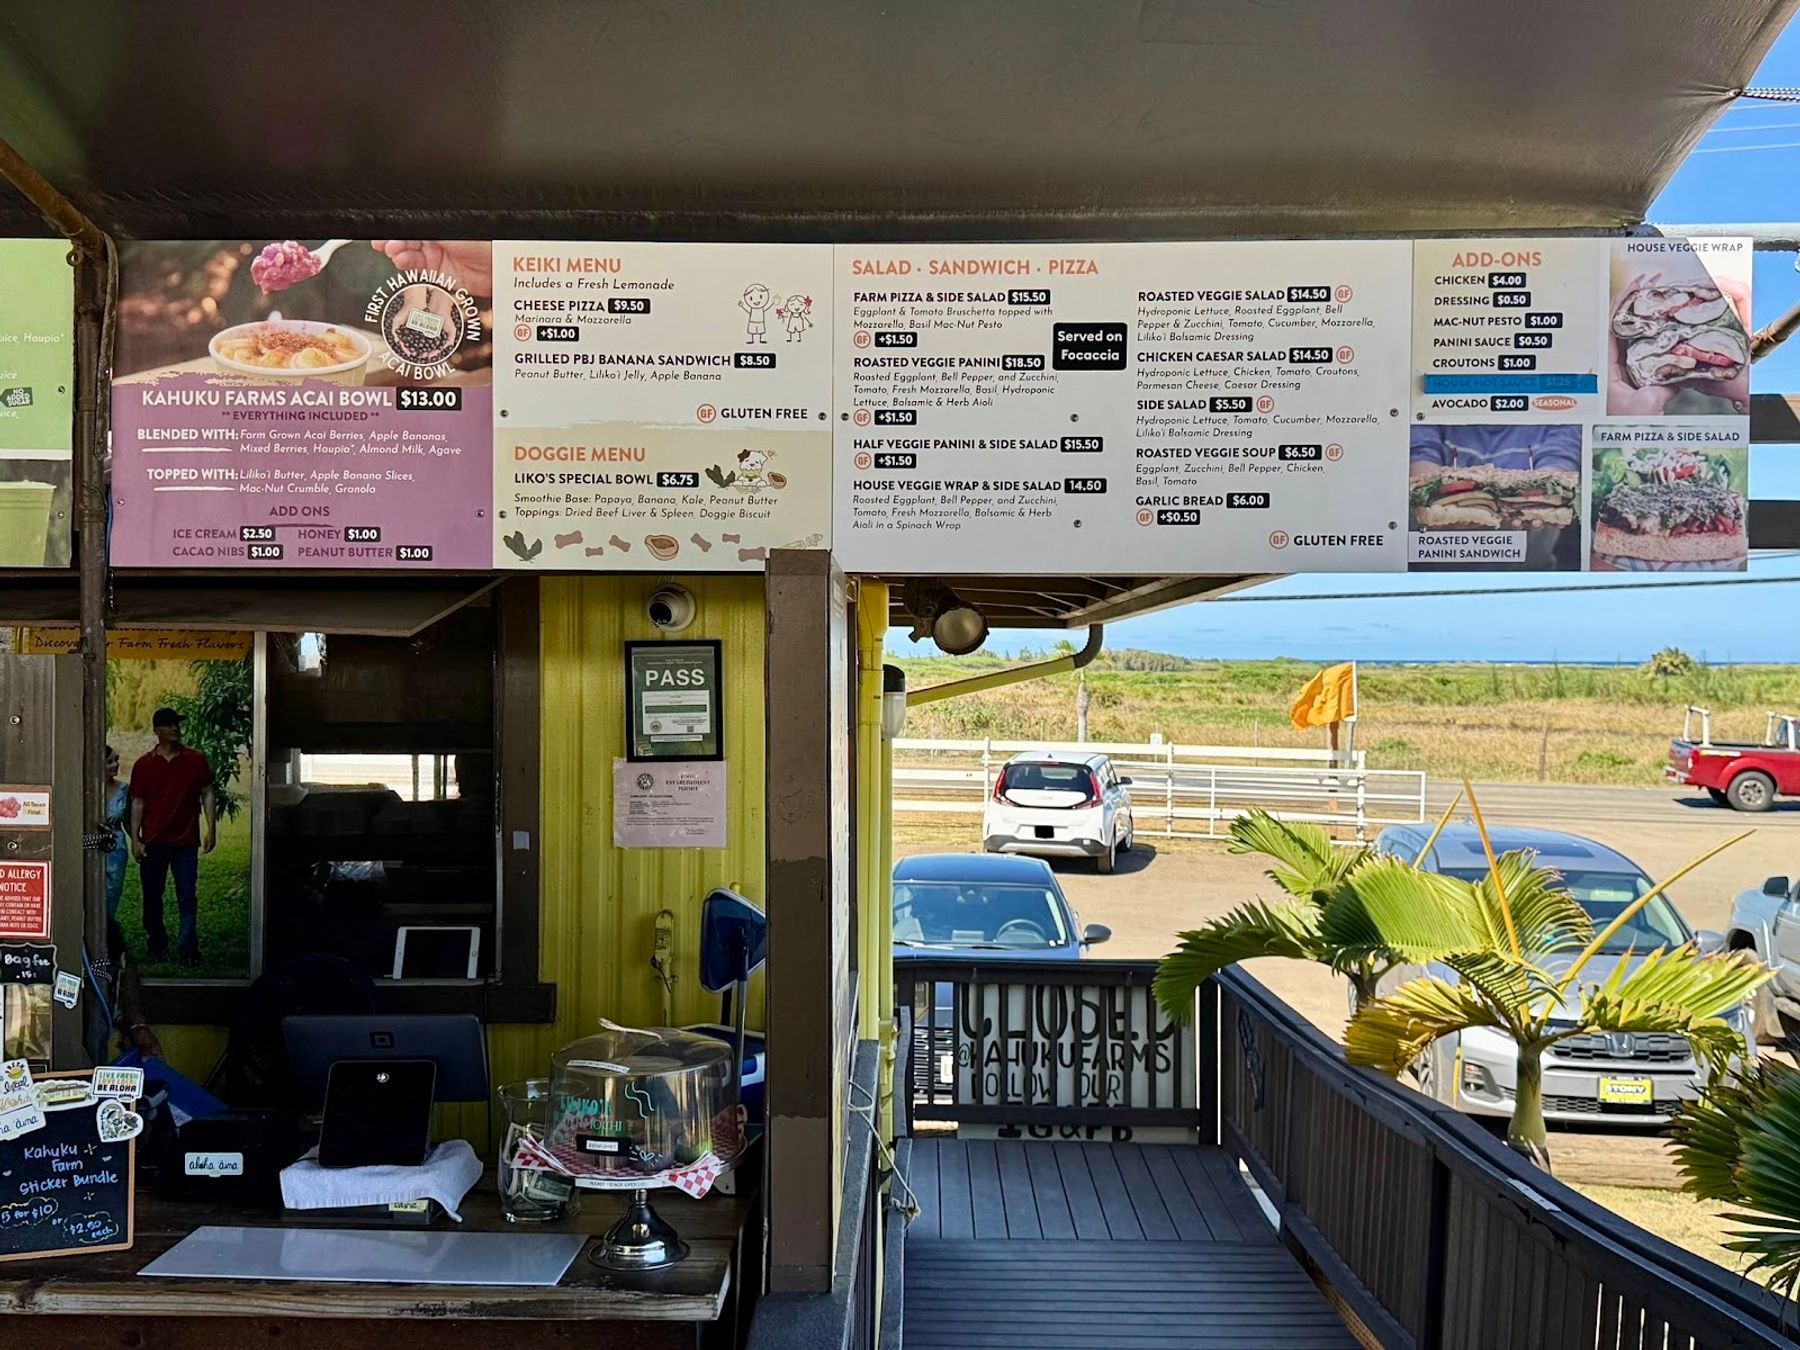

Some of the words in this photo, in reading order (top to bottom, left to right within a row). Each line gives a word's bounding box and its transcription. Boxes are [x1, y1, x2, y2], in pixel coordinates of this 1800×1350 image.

[512, 256, 560, 272] KEIKI
[566, 258, 621, 273] MENU
[1452, 251, 1542, 268] ADD-ONS
[852, 259, 912, 275] SALAD
[928, 259, 1031, 275] SANDWICH
[1048, 259, 1099, 275] PIZZA
[514, 277, 561, 288] Includes
[577, 278, 609, 289] Fresh
[613, 278, 675, 290] Lemonade
[1434, 276, 1486, 286] CHICKEN
[1492, 275, 1522, 286] $4.00
[853, 292, 888, 303] FARM
[891, 292, 924, 303] PIZZA
[925, 292, 935, 303] &
[936, 292, 965, 303] SIDE
[967, 292, 1006, 303] SALAD
[1011, 291, 1047, 302] $15.50
[1138, 291, 1195, 302] ROASTED
[1196, 291, 1243, 302] VEGGIE
[1245, 290, 1285, 300] SALAD
[1290, 289, 1328, 300] $14.50
[1434, 296, 1490, 306] DRESSING
[1496, 294, 1528, 305] $0.50
[364, 286, 389, 323] FIRST
[386, 268, 457, 292] HAWAIIAN
[455, 287, 481, 342] GROWN
[514, 300, 565, 311] CHEESE
[569, 300, 605, 311] PIZZA
[612, 300, 645, 312] $9.50
[1434, 317, 1485, 326] MAC-NUT
[1488, 317, 1522, 325] PESTO
[1529, 316, 1558, 326] $1.00
[1058, 330, 1103, 342] Served
[1106, 333, 1122, 342] on
[1434, 338, 1472, 347] PANINI
[1475, 337, 1511, 347] SAUCE
[1518, 336, 1548, 346] $0.50
[515, 353, 570, 364] GRILLED
[574, 354, 594, 365] PBJ
[599, 354, 655, 365] BANANA
[658, 355, 730, 366] SANDWICH
[739, 355, 771, 366] $8.50
[1061, 349, 1120, 360] Focaccia
[1137, 352, 1192, 363] CHICKEN
[1196, 351, 1244, 362] CAESAR
[1247, 351, 1286, 361] SALAD
[1292, 350, 1329, 361] $14.50
[378, 351, 411, 377] ACAI
[414, 361, 456, 380] BOWL
[853, 357, 909, 368] ROASTED
[911, 357, 956, 368] VEGGIE
[957, 357, 1000, 368] PANINI
[1004, 357, 1042, 368] $18.50
[1433, 358, 1495, 368] CROUTONS
[1502, 358, 1531, 368] $1.00
[143, 390, 219, 406] KAHUKU
[225, 390, 287, 406] FARMS
[290, 390, 333, 407] ACAI
[338, 389, 394, 408] BOWL
[400, 390, 457, 408] $13.00
[1136, 400, 1166, 410] SIDE
[1167, 400, 1207, 410] SALAD
[1214, 399, 1246, 410] $5.50
[1432, 399, 1488, 409] AVOCADO
[1494, 399, 1525, 409] $2.00
[1534, 399, 1576, 407] SEASONAL
[233, 410, 306, 420] EVERYTHING
[309, 410, 368, 422] INCLUDED
[137, 428, 199, 442] BLENDED
[201, 428, 239, 442] WITH:
[240, 429, 266, 439] Farm
[269, 429, 301, 440] Grown
[304, 430, 328, 439] Acai
[329, 429, 366, 442] Berries,
[368, 430, 399, 442] Apple
[402, 430, 448, 443] Bananas,
[513, 446, 588, 462] DOGGIE
[589, 446, 645, 462] MENU
[1136, 448, 1194, 458] ROASTED
[1195, 448, 1240, 458] VEGGIE
[1241, 448, 1276, 458] SOUP
[1284, 447, 1316, 458] $6.50
[559, 473, 612, 484] SPECIAL
[616, 474, 653, 485] BOWL
[661, 474, 695, 486] $6.75
[853, 480, 896, 491] HOUSE
[897, 480, 942, 491] VEGGIE
[944, 480, 979, 491] WRAP
[982, 480, 991, 491] &
[992, 480, 1021, 490] SIDE
[1022, 481, 1061, 491] SALAD
[1068, 480, 1102, 491] 14.50
[1135, 496, 1181, 506] GARLIC
[1182, 496, 1224, 506] BREAD
[1232, 495, 1264, 506] $6.00
[269, 506, 298, 518] ADD
[301, 506, 330, 517] ONS
[852, 521, 873, 529] Aioli
[896, 521, 932, 530] Spinach
[936, 521, 961, 531] Wrap
[172, 528, 192, 539] ICE
[194, 528, 237, 540] CREAM
[242, 528, 273, 540] $2.50
[298, 528, 341, 540] HONEY
[347, 528, 378, 540] $1.00
[1293, 535, 1347, 546] GLUTEN
[1349, 535, 1384, 546] FREE
[1418, 536, 1469, 545] ROASTED
[1472, 536, 1512, 545] VEGGIE
[1418, 549, 1456, 558] PANINI
[1459, 548, 1520, 558] SANDWICH
[158, 637, 192, 649] Fresh
[645, 668, 705, 687] PASS
[8, 869, 42, 879] ALLERGY
[24, 1144, 78, 1159] Kahuku
[52, 1158, 83, 1172] Farm
[19, 1178, 67, 1195] Sticker
[73, 1171, 118, 1187] Bundle
